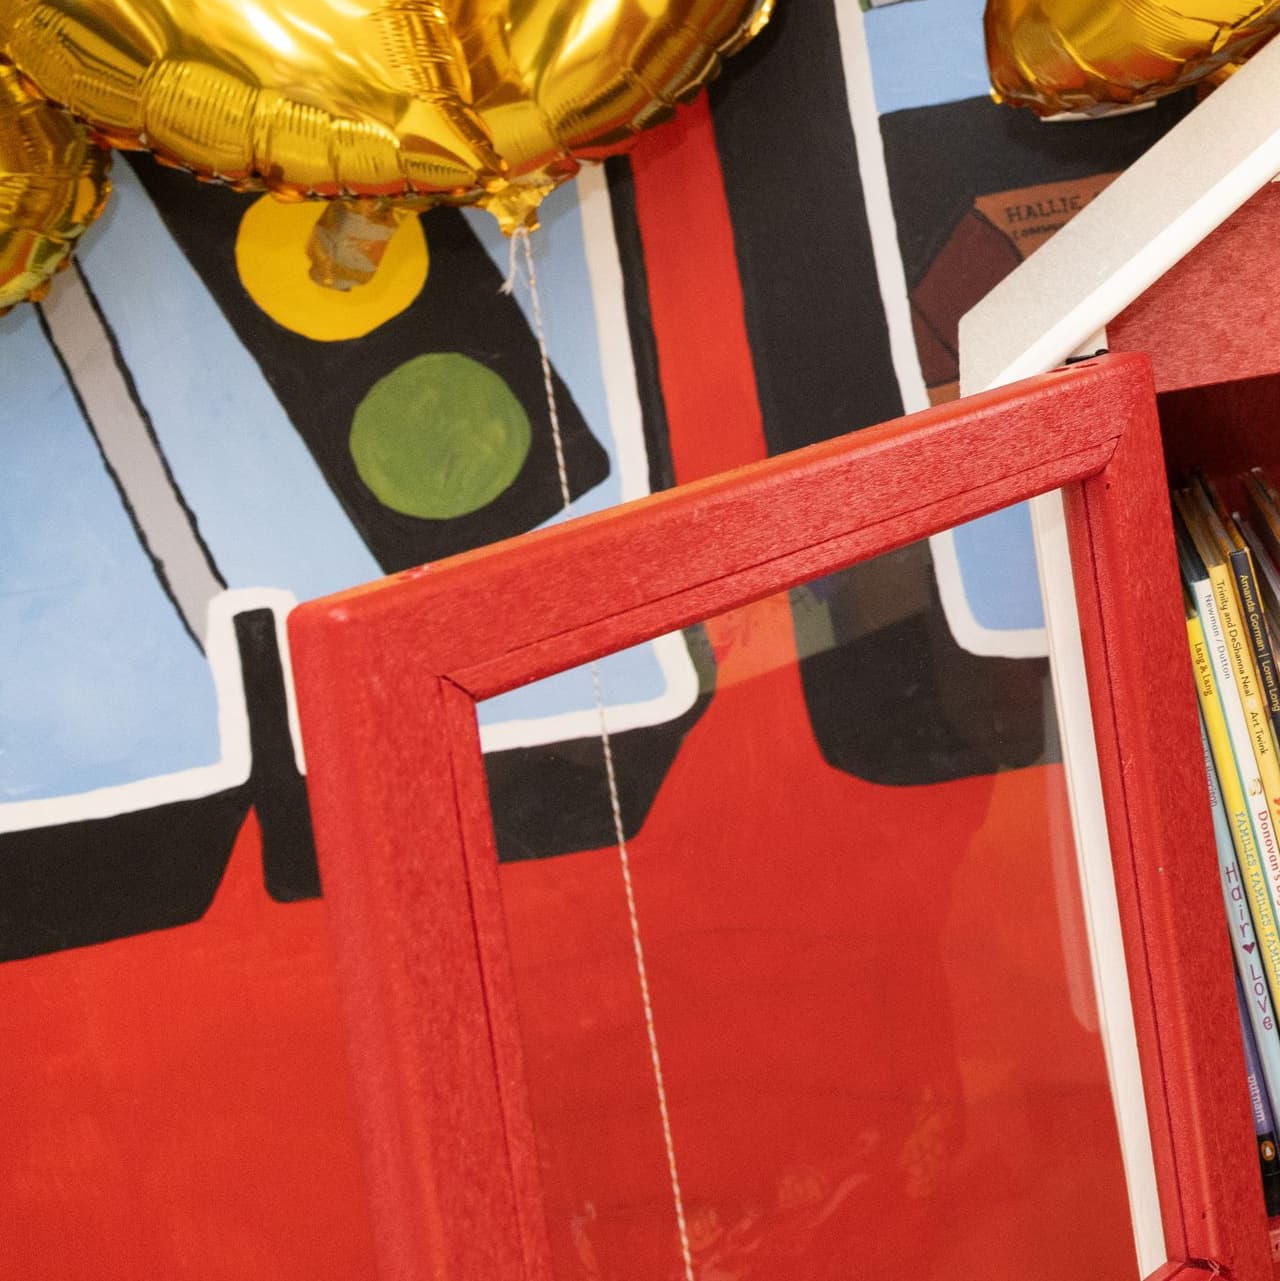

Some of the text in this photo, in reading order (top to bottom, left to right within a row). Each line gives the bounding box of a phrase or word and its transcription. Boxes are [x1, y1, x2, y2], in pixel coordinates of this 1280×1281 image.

[1192, 642, 1207, 665] Lang
[1202, 594, 1233, 680] Newman Dutton
[1213, 580, 1269, 756] Trinity and DeShanna Neal Art Twink
[1238, 574, 1256, 612] Amanda
[1248, 613, 1266, 652] Gorman
[1261, 660, 1276, 687] Loren
[1199, 674, 1214, 696] Lang
